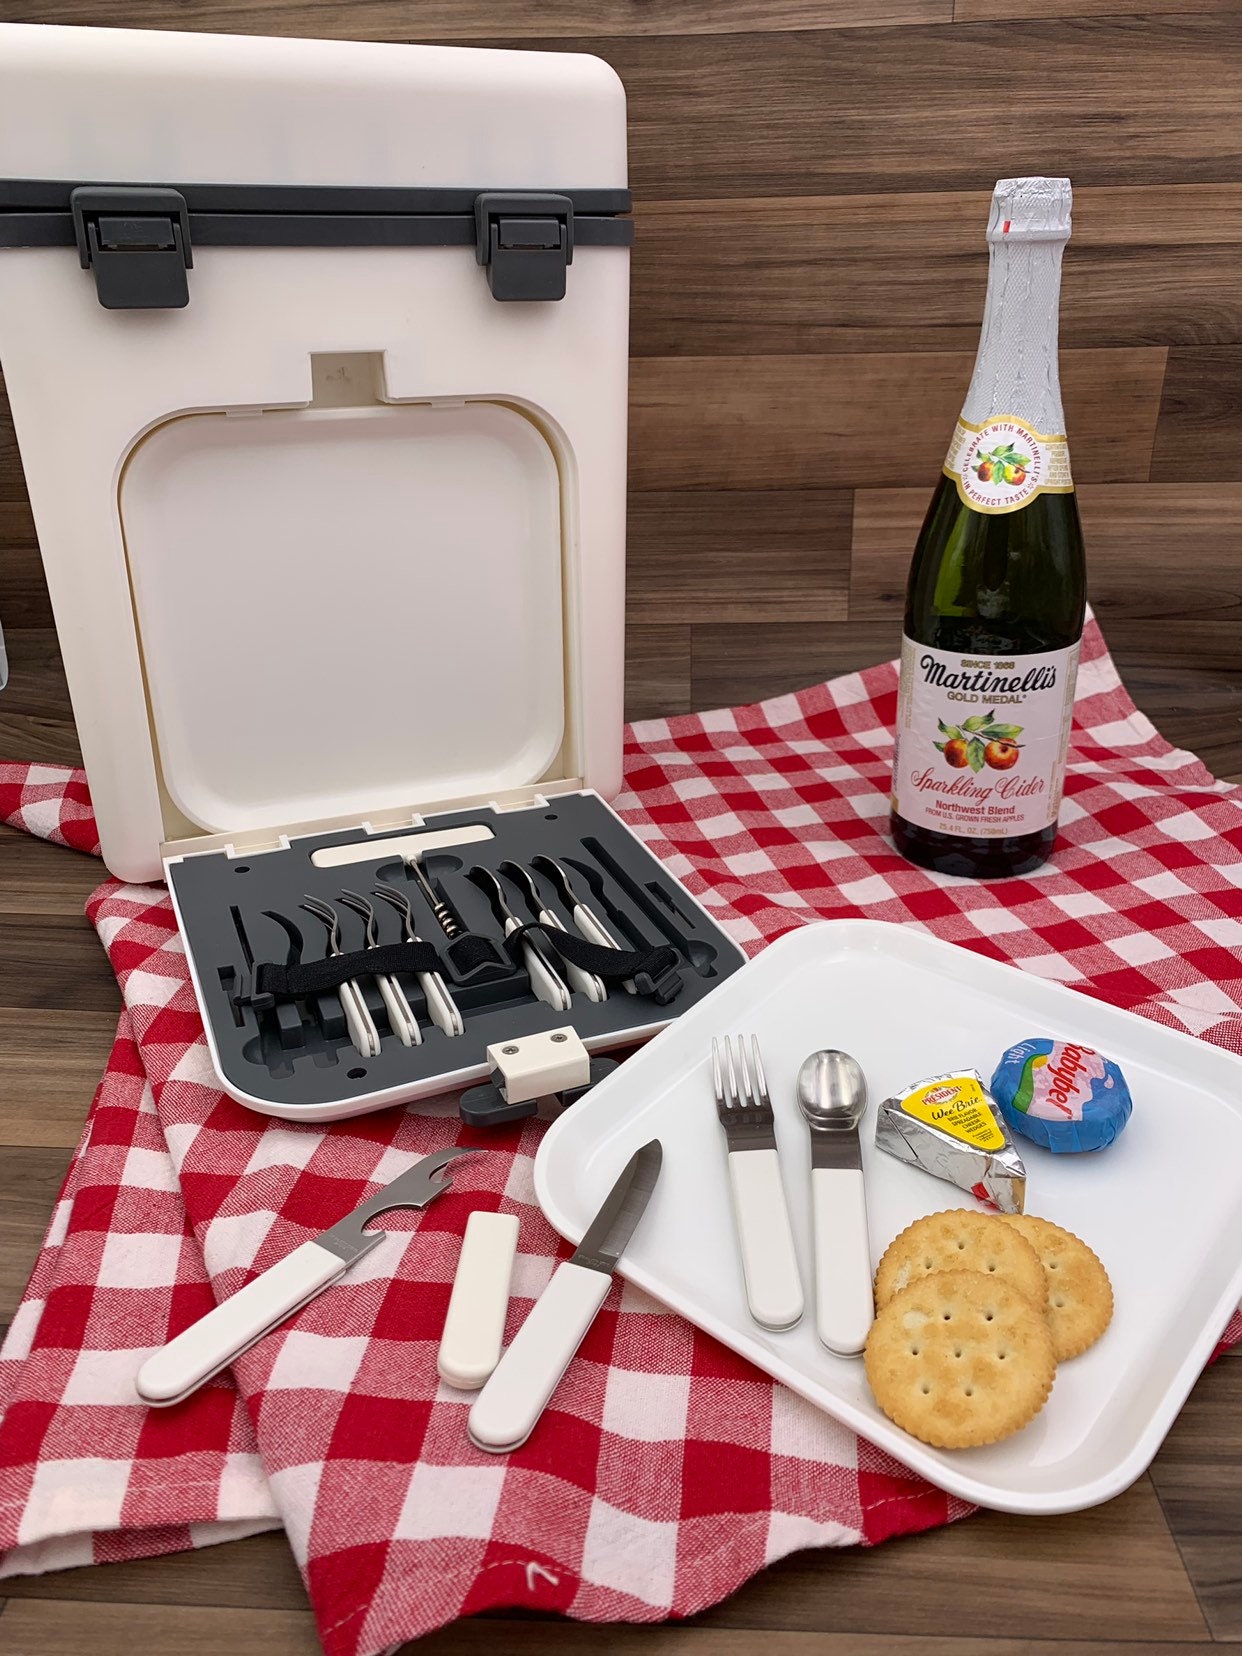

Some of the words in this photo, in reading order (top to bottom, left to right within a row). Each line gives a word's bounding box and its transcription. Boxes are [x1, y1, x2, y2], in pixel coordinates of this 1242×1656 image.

[962, 430, 989, 472] CELEBRATE
[991, 424, 1014, 432] WITH
[964, 481, 971, 490] IN
[968, 489, 1001, 506] PERFECT
[1005, 488, 1029, 504] TASTE
[960, 659, 991, 670] SINCE
[920, 654, 1057, 693] Martinelli's
[947, 691, 979, 704] GOLD
[910, 767, 994, 806] Sparkling
[995, 775, 1044, 799] Cider
[925, 807, 941, 817] FROM
[942, 811, 954, 820] U.S.
[955, 813, 979, 822] GROWN
[980, 815, 1000, 823] FRESH
[1002, 814, 1025, 823] APPLES
[935, 800, 985, 815] Northwest
[988, 805, 1015, 815] Blend
[939, 822, 954, 831] 25.4
[954, 825, 965, 833] FL.
[1004, 1042, 1037, 1065] Light
[931, 1109, 955, 1120] Wee
[953, 1096, 979, 1111] Brie
[959, 1108, 977, 1118] FLAVOR
[962, 1119, 981, 1128] CHEESE
[965, 1122, 987, 1133] WEDGES
